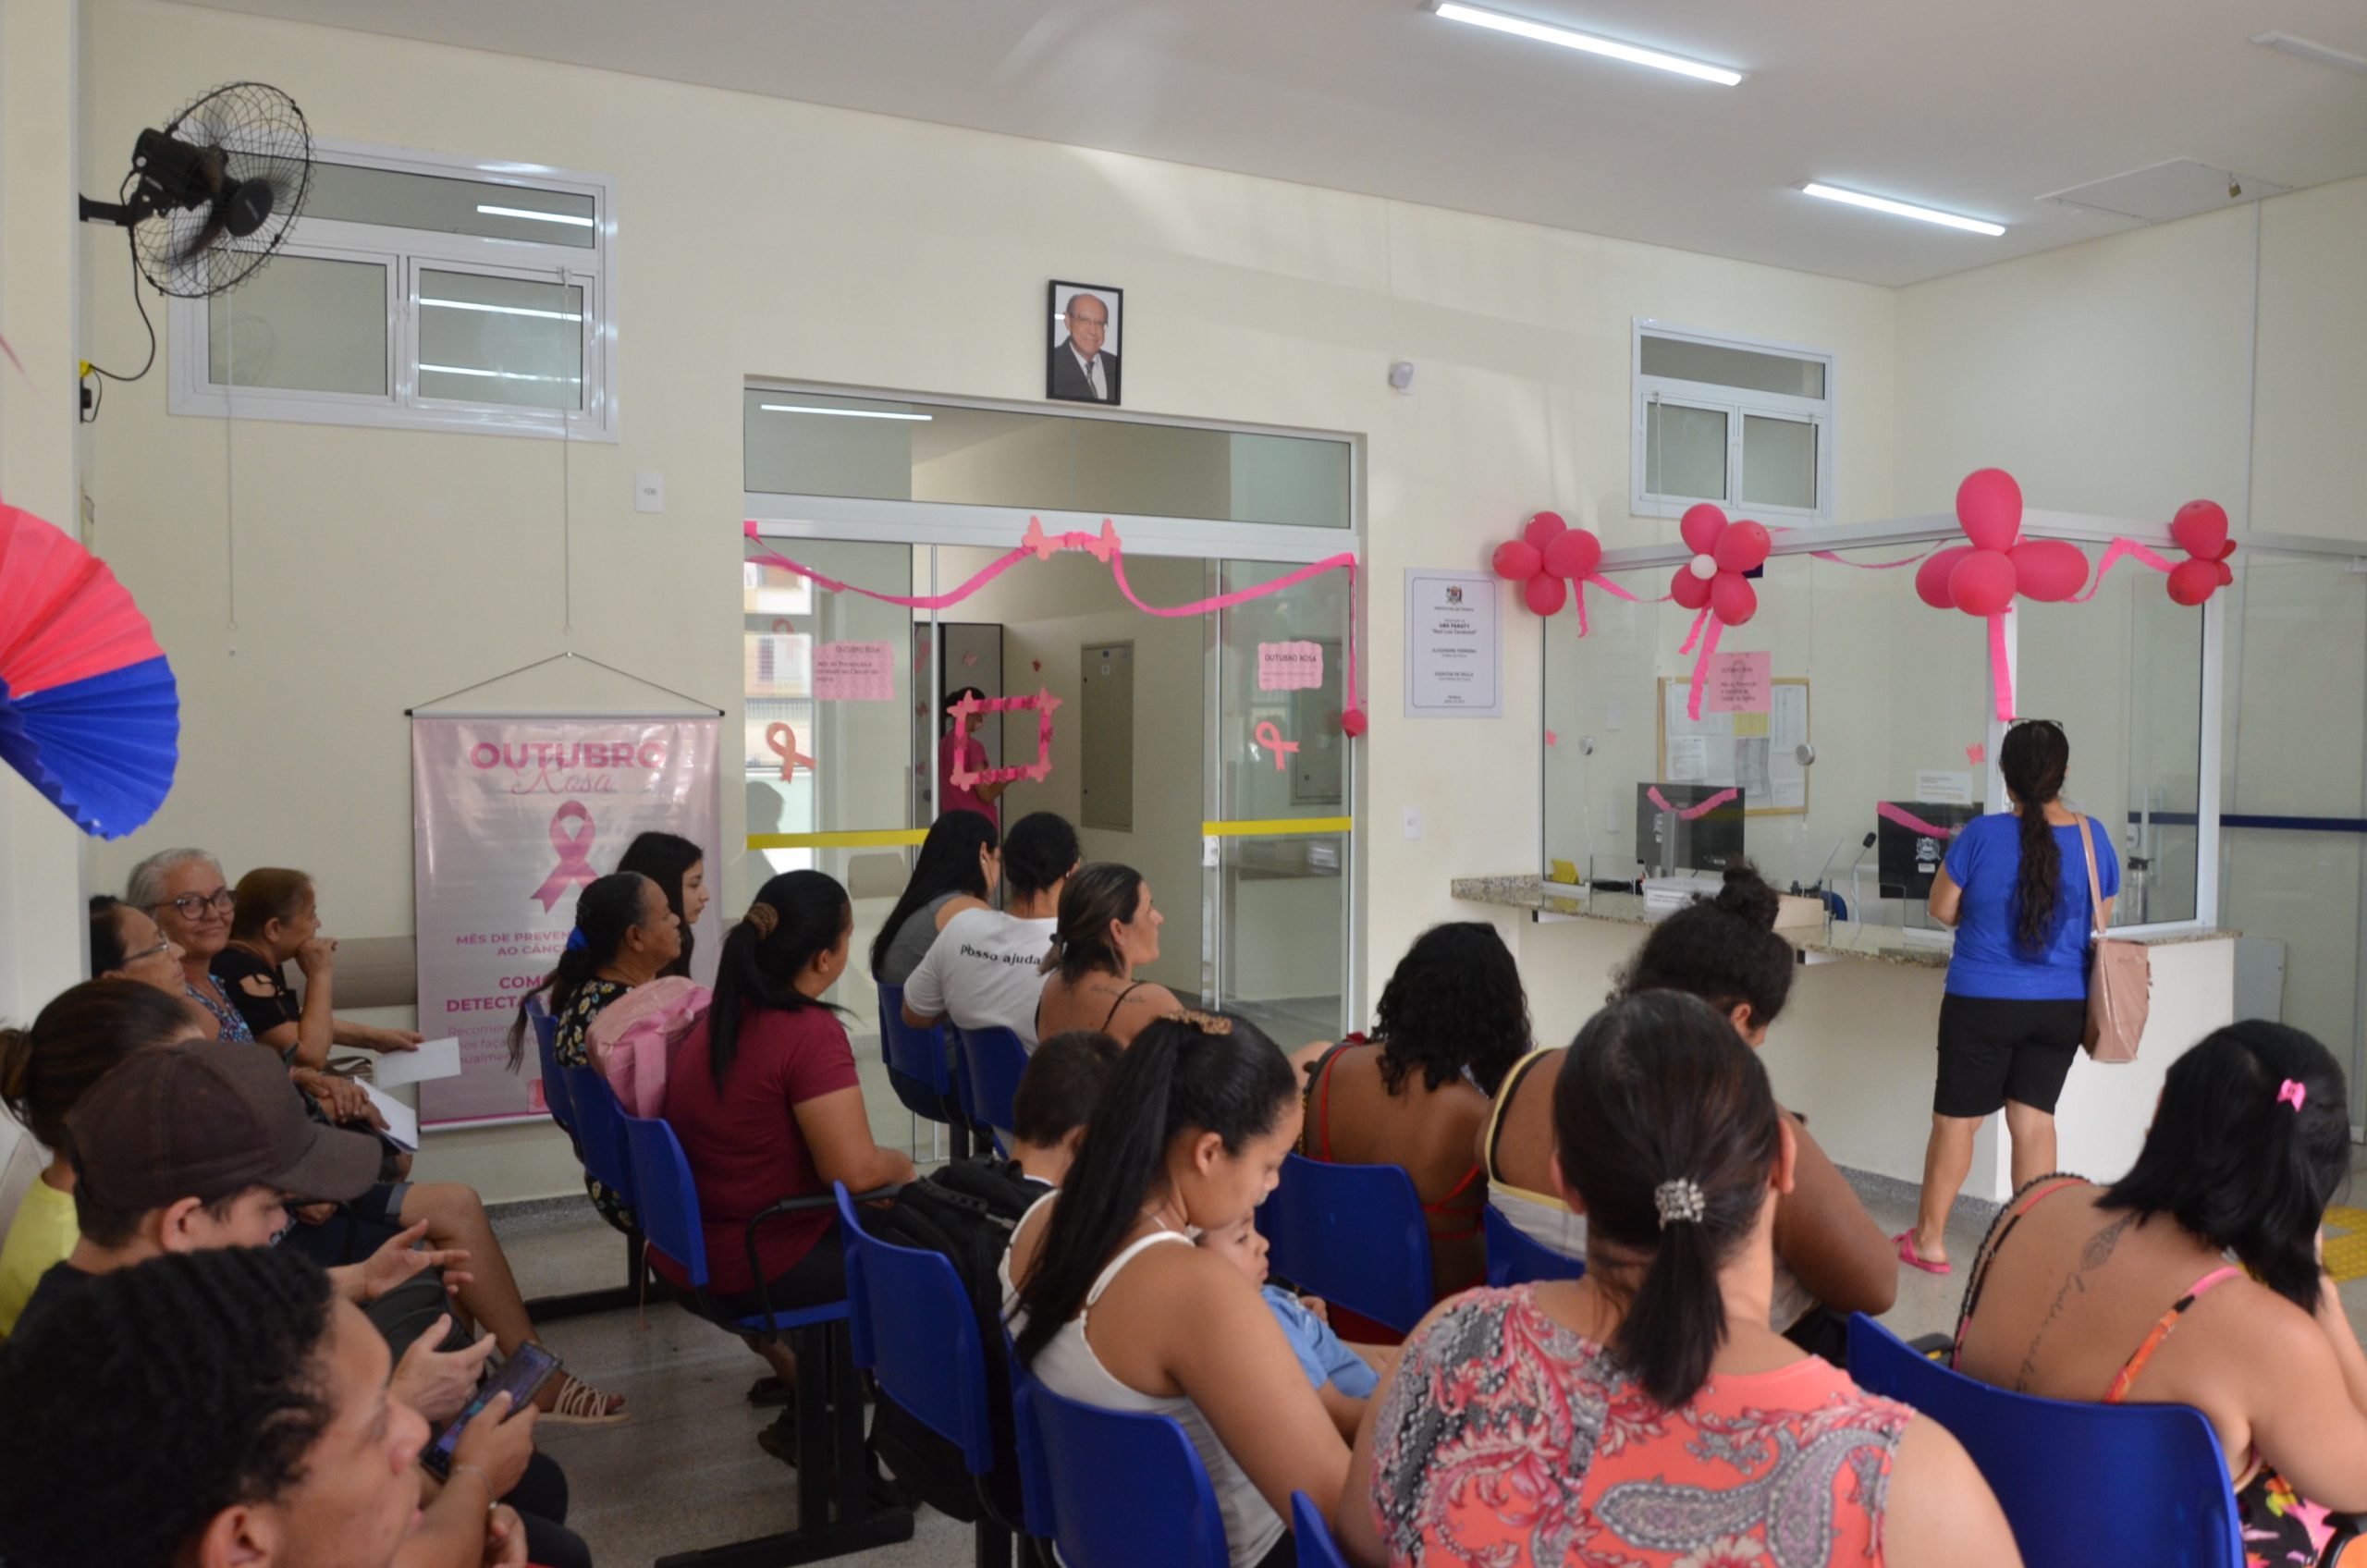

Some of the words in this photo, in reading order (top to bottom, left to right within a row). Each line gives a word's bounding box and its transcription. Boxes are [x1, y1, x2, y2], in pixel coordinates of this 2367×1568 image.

[1265, 654, 1297, 663] OUTUBRO
[1299, 654, 1318, 663] ROSA
[470, 741, 666, 770] OUTUBRO
[510, 758, 614, 795] Rosa
[457, 934, 486, 945] MÊS
[491, 934, 510, 943] DE
[497, 947, 518, 956] AO
